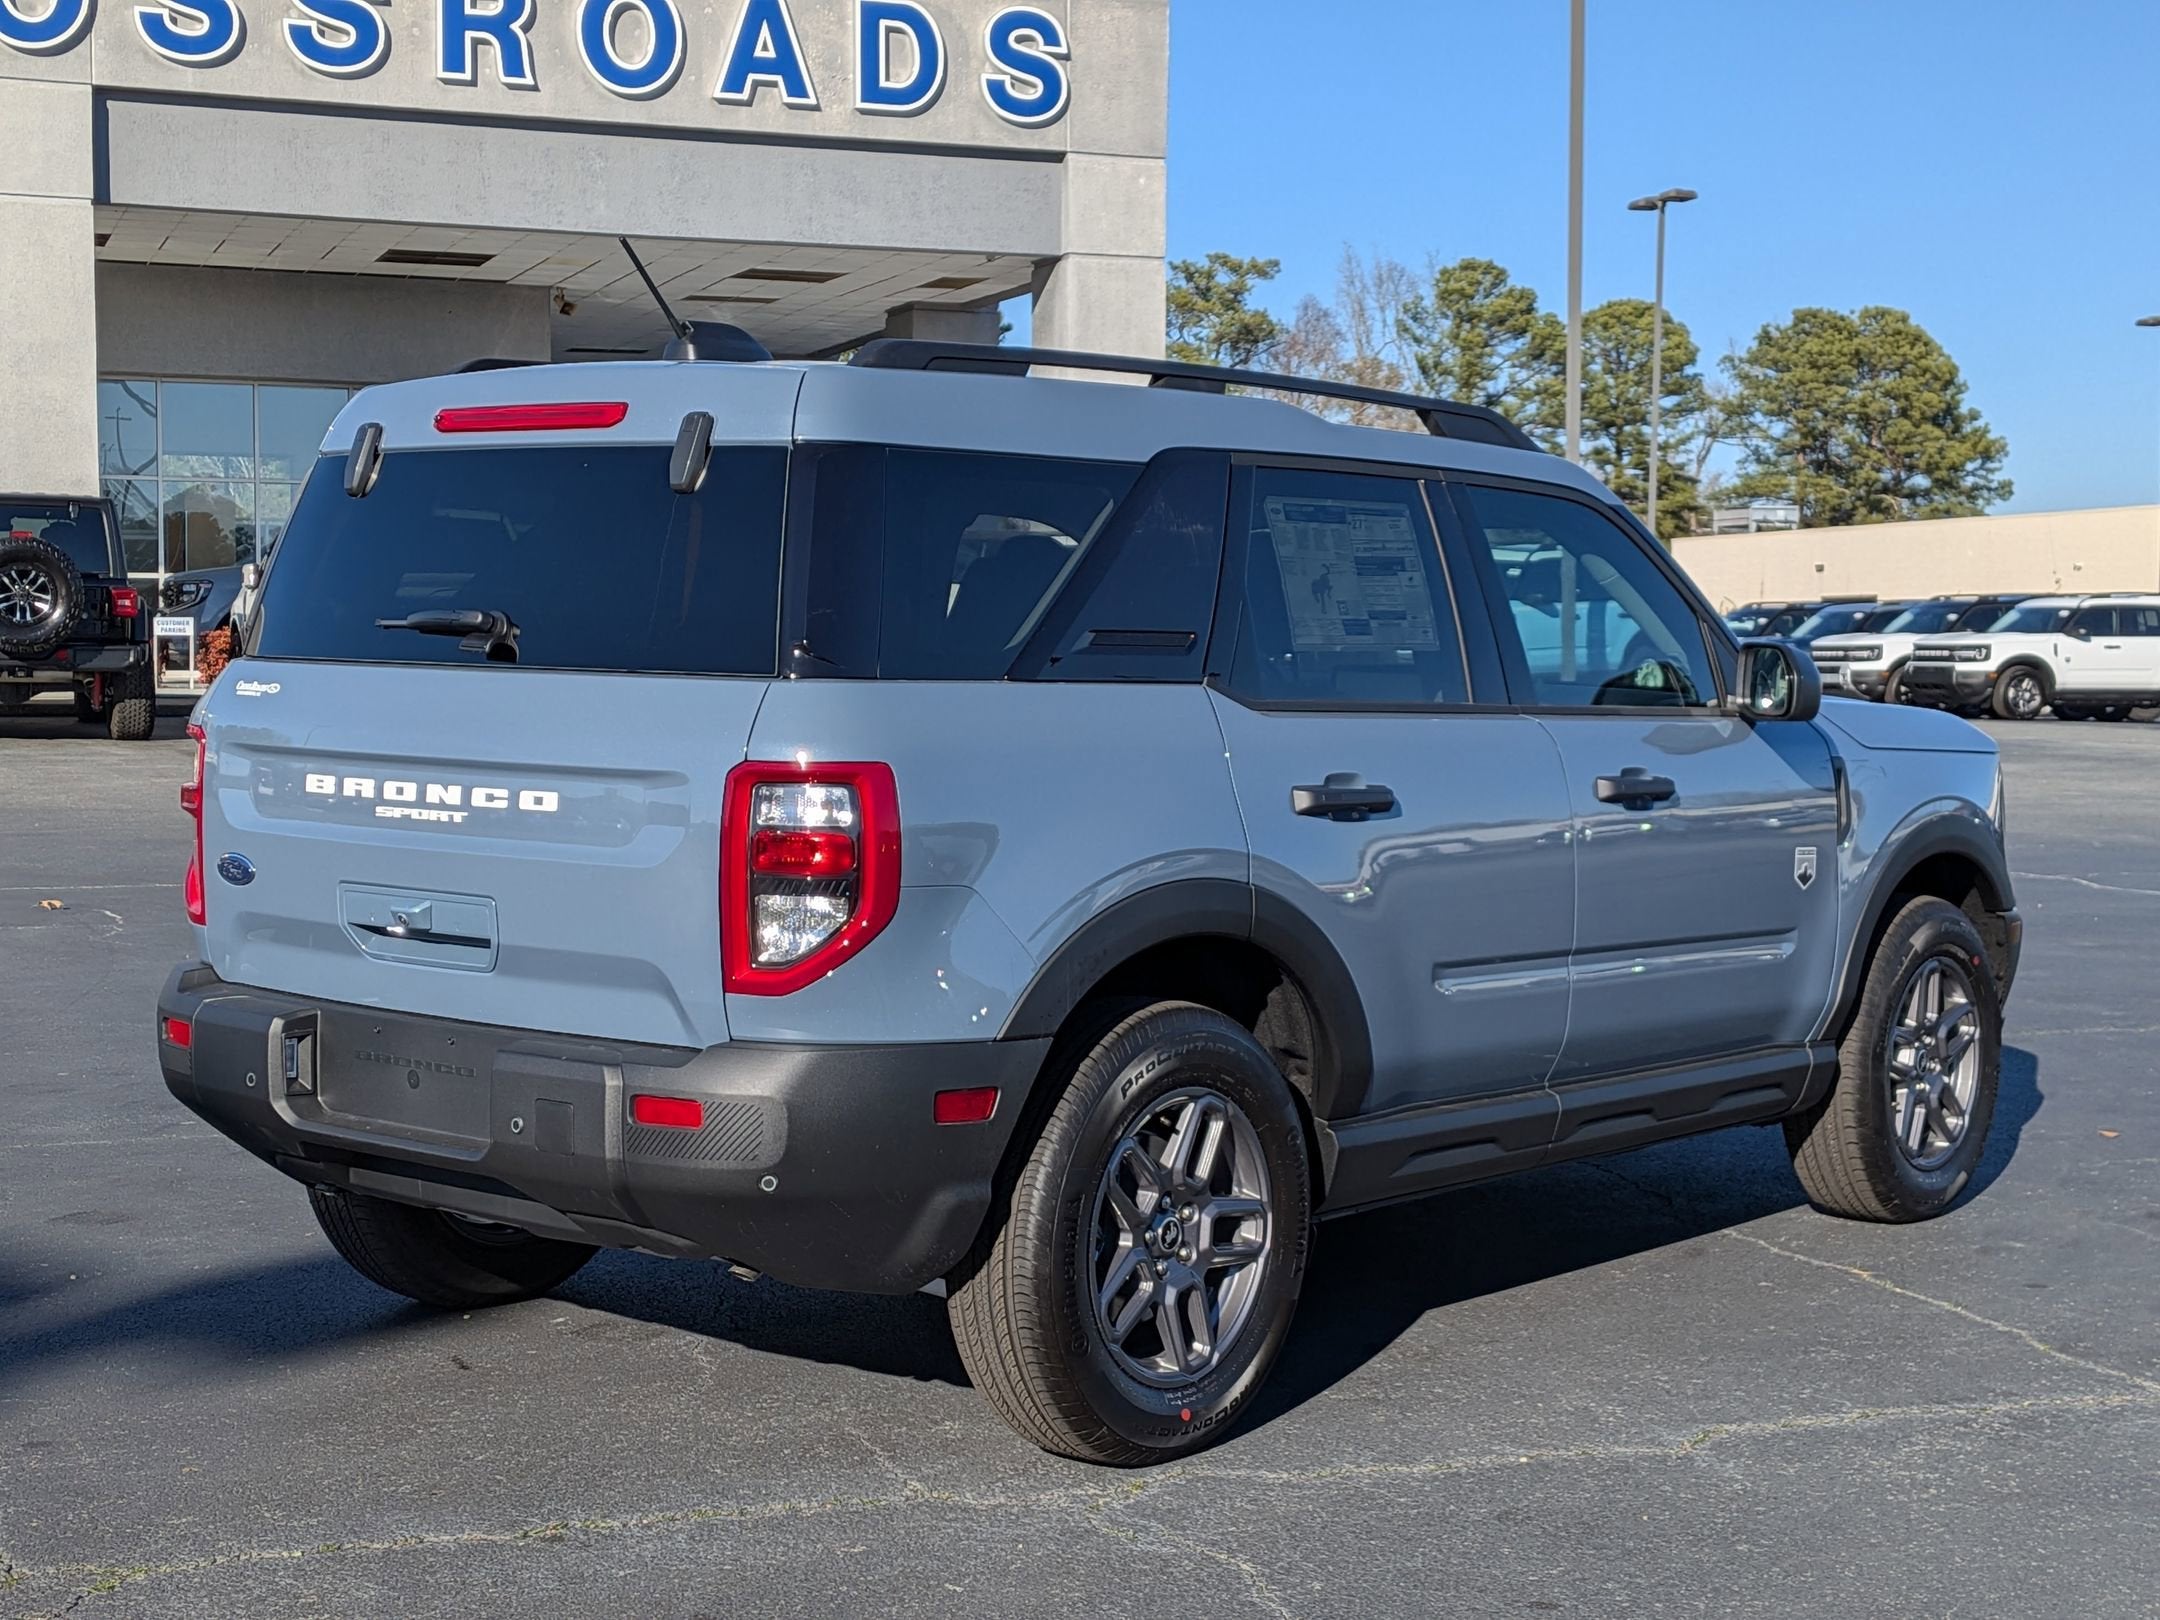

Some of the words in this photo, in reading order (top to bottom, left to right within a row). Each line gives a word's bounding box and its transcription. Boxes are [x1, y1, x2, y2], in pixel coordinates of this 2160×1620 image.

[305, 773, 559, 812] BRONCO
[375, 805, 469, 823] SPORT
[353, 1049, 476, 1078] BRONCO
